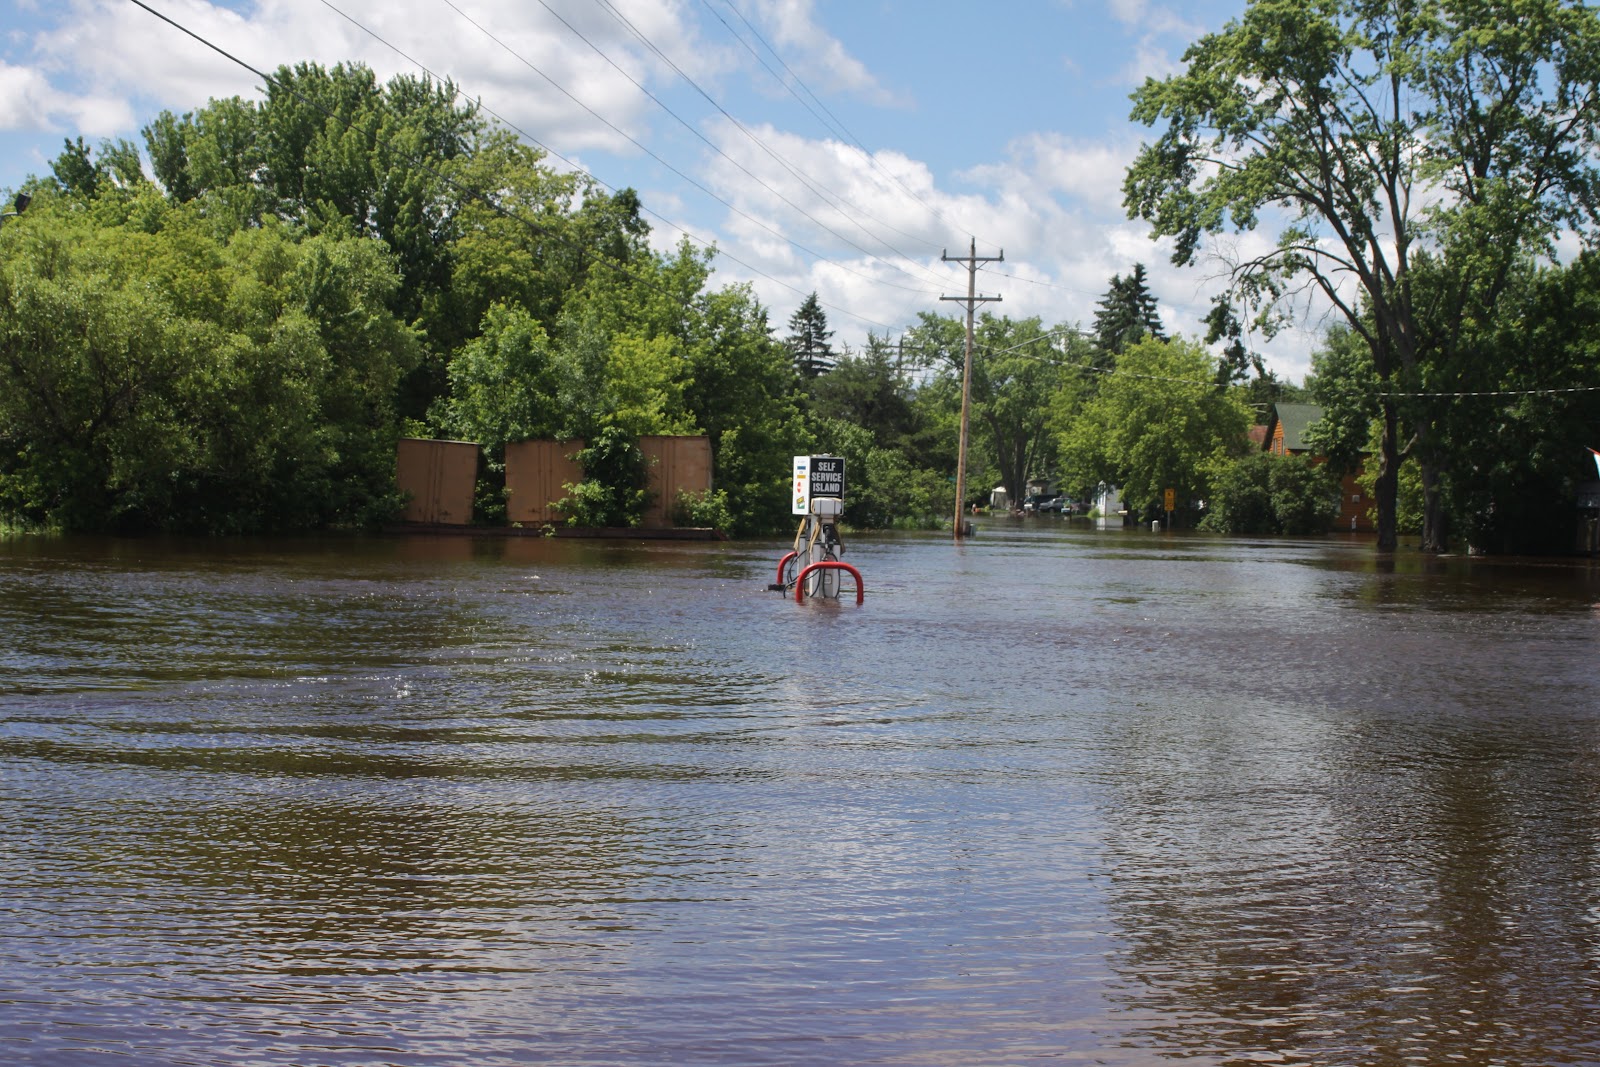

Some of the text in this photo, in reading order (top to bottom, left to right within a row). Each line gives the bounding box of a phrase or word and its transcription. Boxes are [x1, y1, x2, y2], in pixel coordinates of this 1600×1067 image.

[818, 462, 836, 471] SELF
[812, 472, 842, 482] SERVICE
[812, 482, 840, 492] ISLAND
